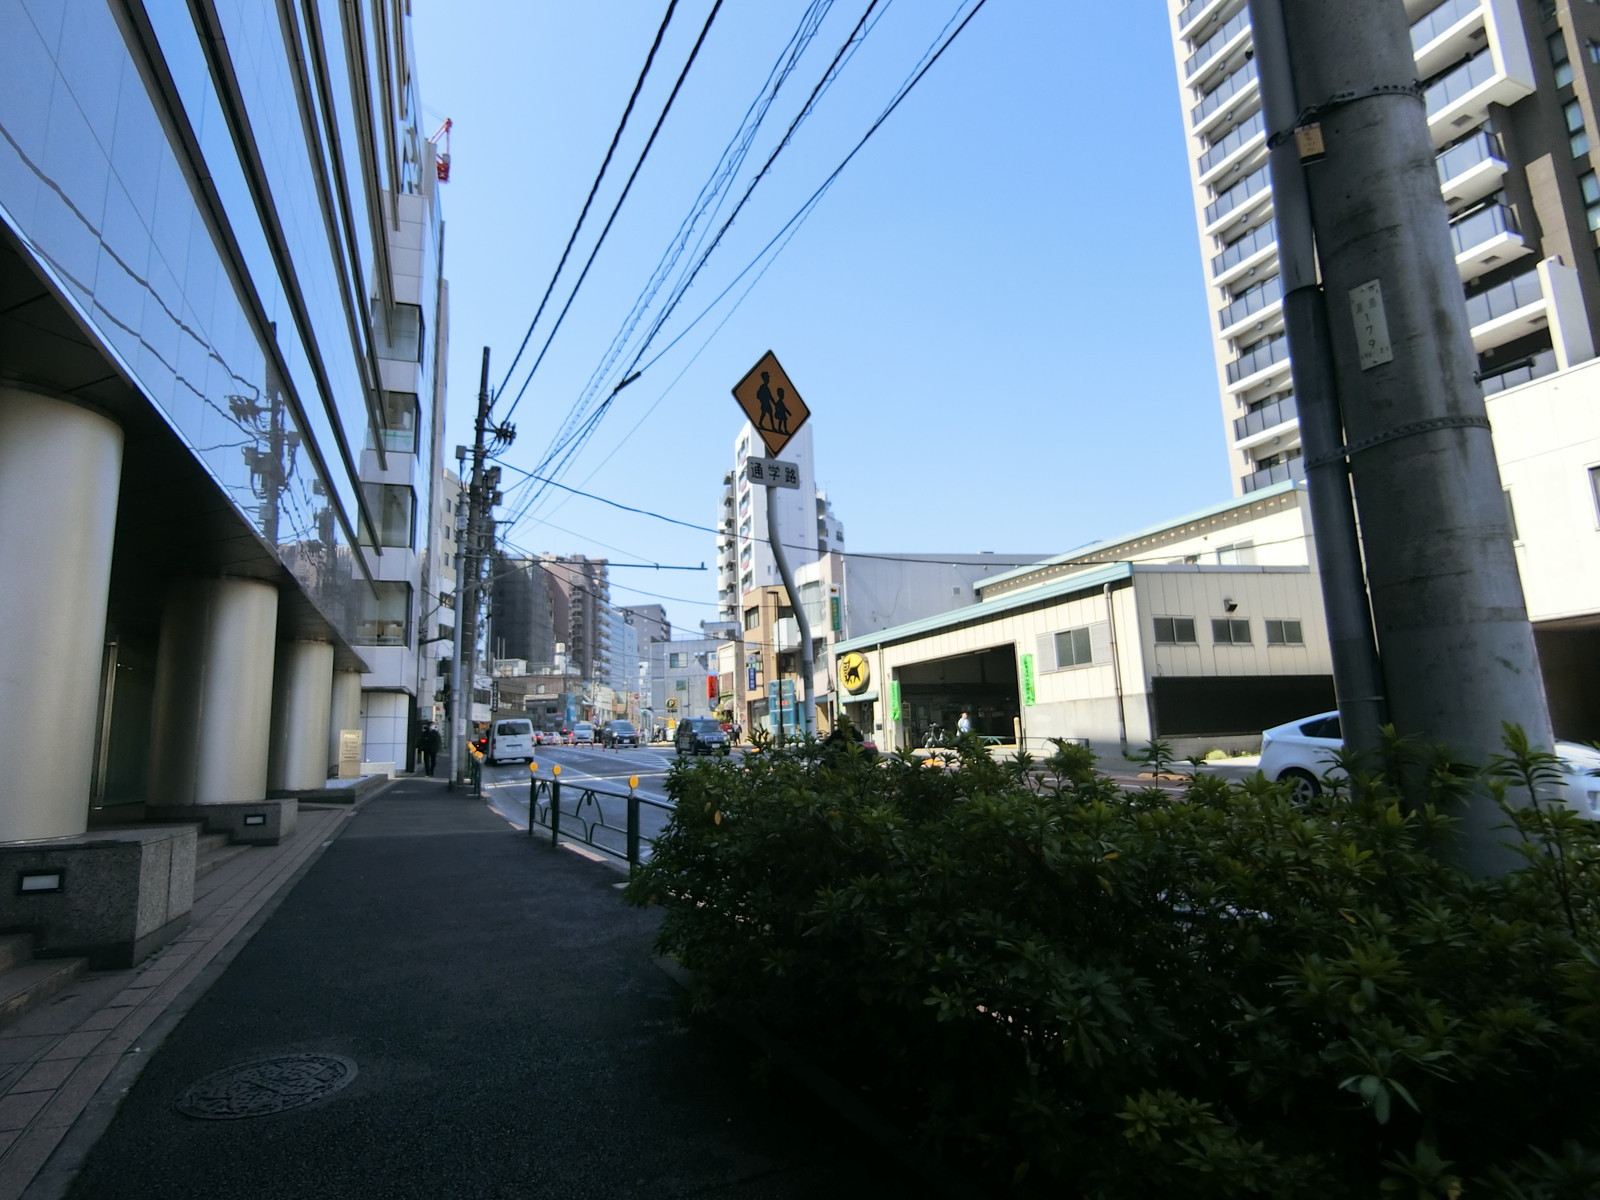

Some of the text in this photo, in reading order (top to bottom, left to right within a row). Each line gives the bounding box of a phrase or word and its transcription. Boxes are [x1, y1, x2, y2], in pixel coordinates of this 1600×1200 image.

[1364, 312, 1376, 350] 179
[751, 462, 796, 484] 通学路
